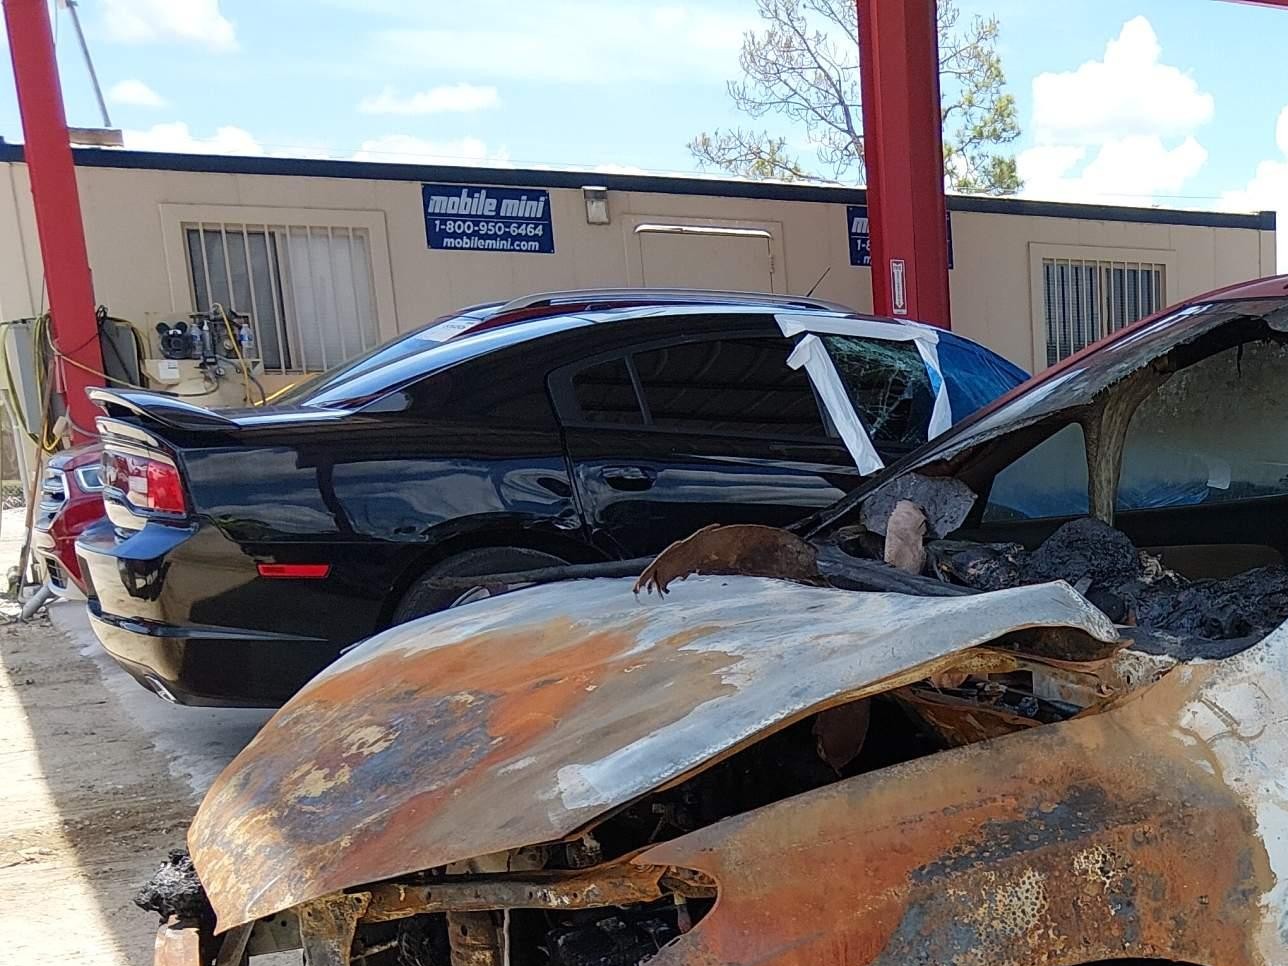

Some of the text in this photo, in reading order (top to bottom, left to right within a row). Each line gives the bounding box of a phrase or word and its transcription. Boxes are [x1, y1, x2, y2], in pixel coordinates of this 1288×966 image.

[428, 188, 546, 218] mobile mini
[434, 220, 544, 236] 1-800-950-6464
[442, 236, 540, 251] mobilemini.com
